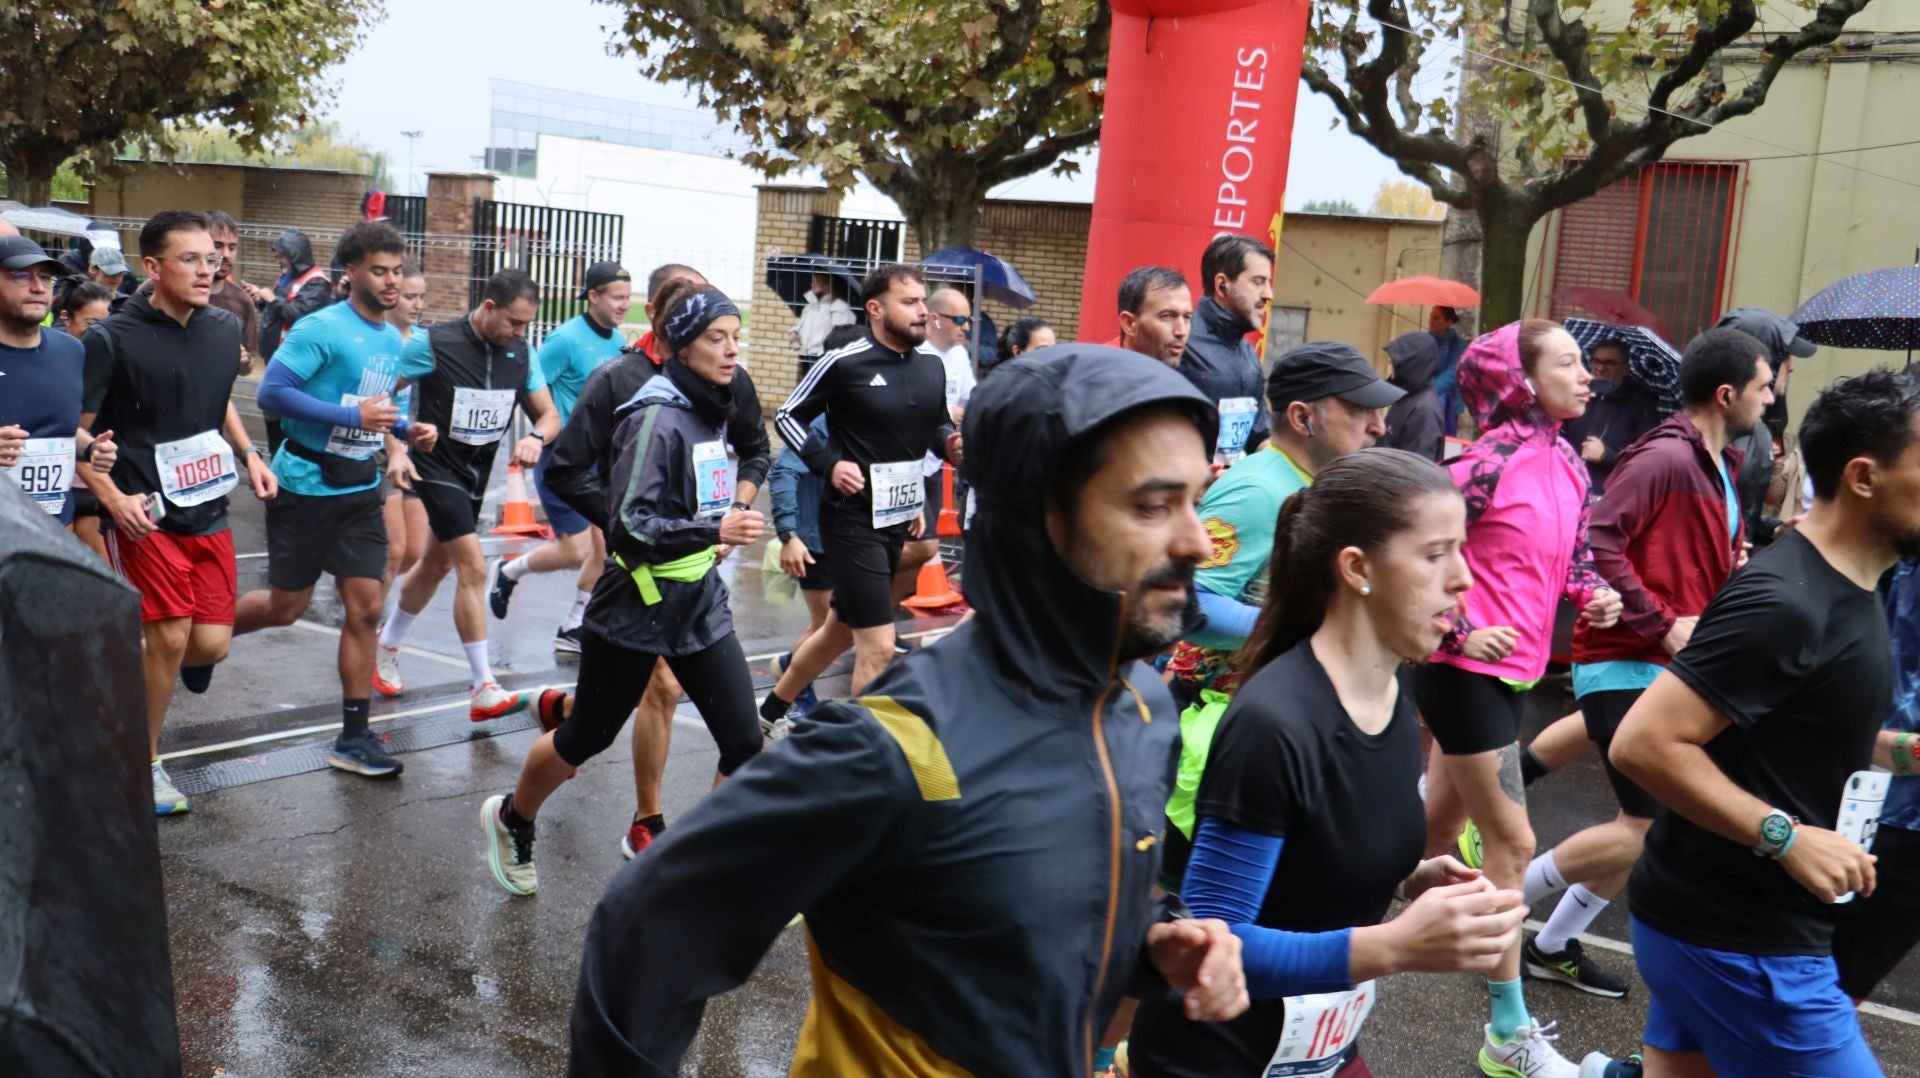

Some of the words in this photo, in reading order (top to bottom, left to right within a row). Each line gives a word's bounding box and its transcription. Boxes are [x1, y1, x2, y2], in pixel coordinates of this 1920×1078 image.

[468, 408, 498, 429] 1134
[21, 464, 62, 492] 992
[175, 453, 222, 489] 1080
[889, 482, 917, 507] 1155
[1305, 991, 1367, 1059] 1147
